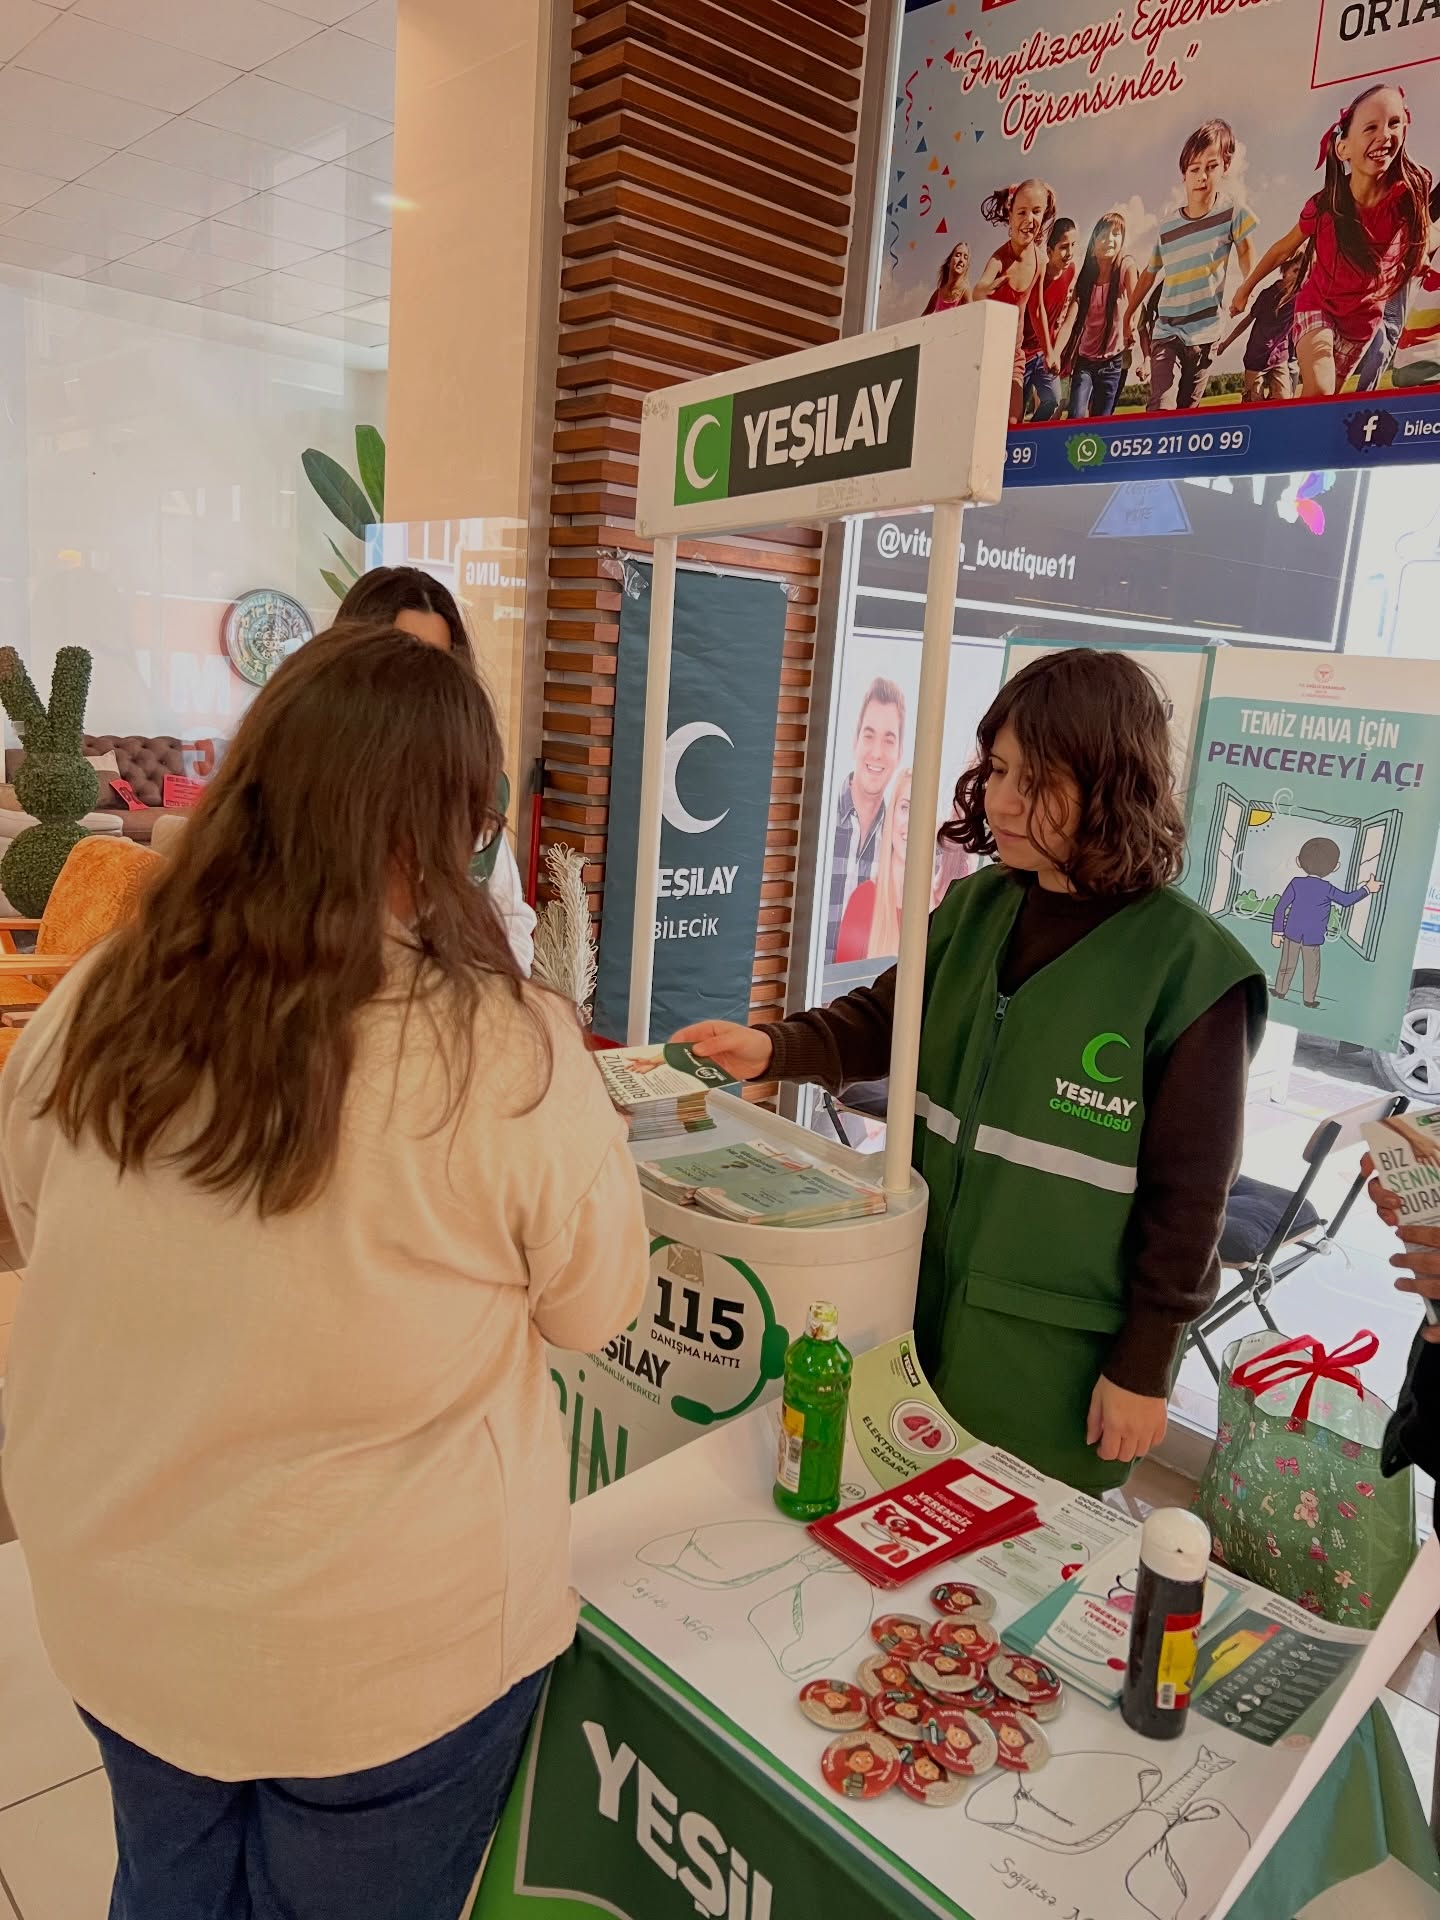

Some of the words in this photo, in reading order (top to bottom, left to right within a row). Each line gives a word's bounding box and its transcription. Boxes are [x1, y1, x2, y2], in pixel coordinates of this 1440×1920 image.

[743, 378, 903, 468] YEŞİLAY
[1012, 447, 1032, 464] 99
[1110, 438, 1153, 458] 0552
[1158, 436, 1182, 455] 211
[1188, 433, 1214, 451] 00
[1219, 430, 1244, 450] 99
[1241, 708, 1297, 738] TEMİZ
[1301, 714, 1351, 744] HAVA
[1357, 715, 1400, 751] İÇİN
[1208, 741, 1367, 781] PENCEREYİ
[1371, 760, 1424, 792] AÇ!
[657, 866, 739, 900] EŞİLAY
[654, 913, 720, 940] BİLECİK
[1049, 1098, 1132, 1132] GÖNÜLLÜSÜ
[1055, 1078, 1137, 1116] YEŞİLAY
[653, 1276, 745, 1351] 115
[602, 1334, 671, 1389] ŞİLAY
[650, 1329, 700, 1355] DANIŞMA
[703, 1350, 741, 1369] HATTI
[862, 1416, 920, 1471] ELEKTRONİK
[871, 1446, 909, 1477] SİGARA
